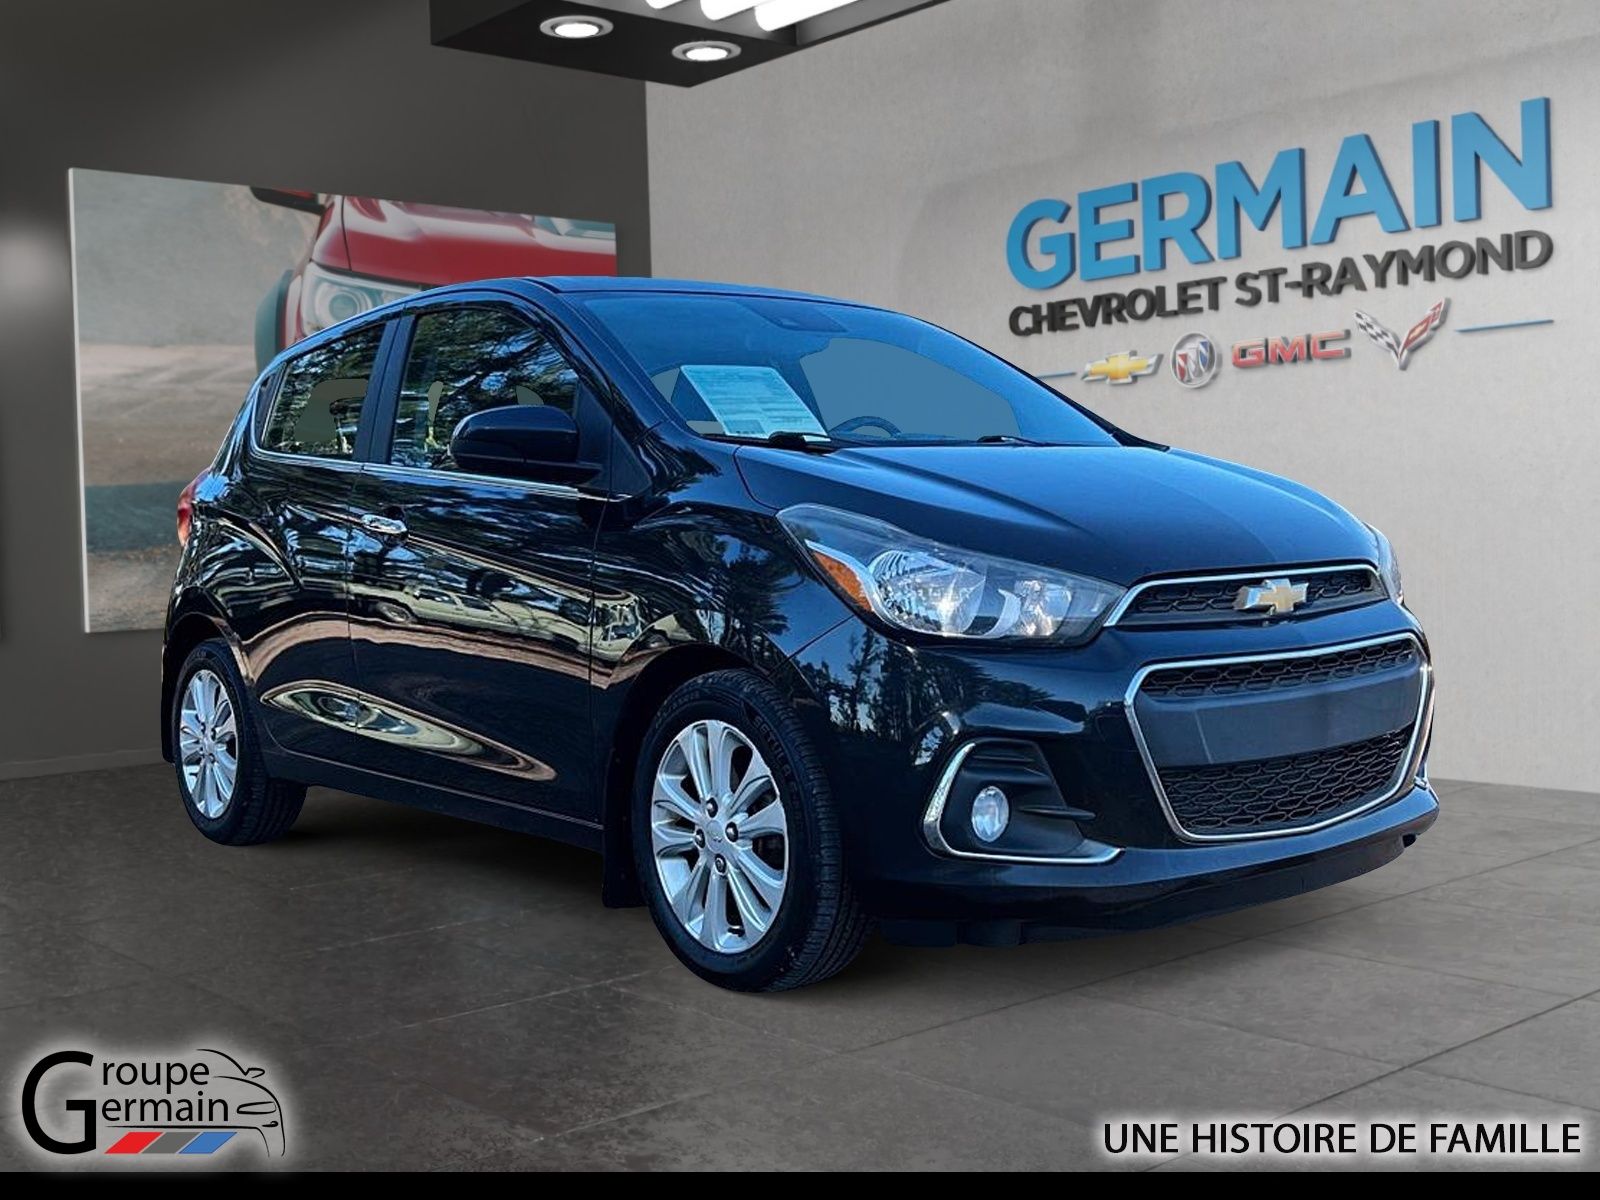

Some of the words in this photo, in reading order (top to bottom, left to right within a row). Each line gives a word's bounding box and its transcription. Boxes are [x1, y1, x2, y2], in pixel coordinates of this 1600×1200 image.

[1006, 97, 1552, 290] GERMAIN
[1008, 276, 1227, 336] CHEVROLET
[1235, 229, 1553, 306] ST-RAYMOND
[1232, 329, 1351, 368] GMC
